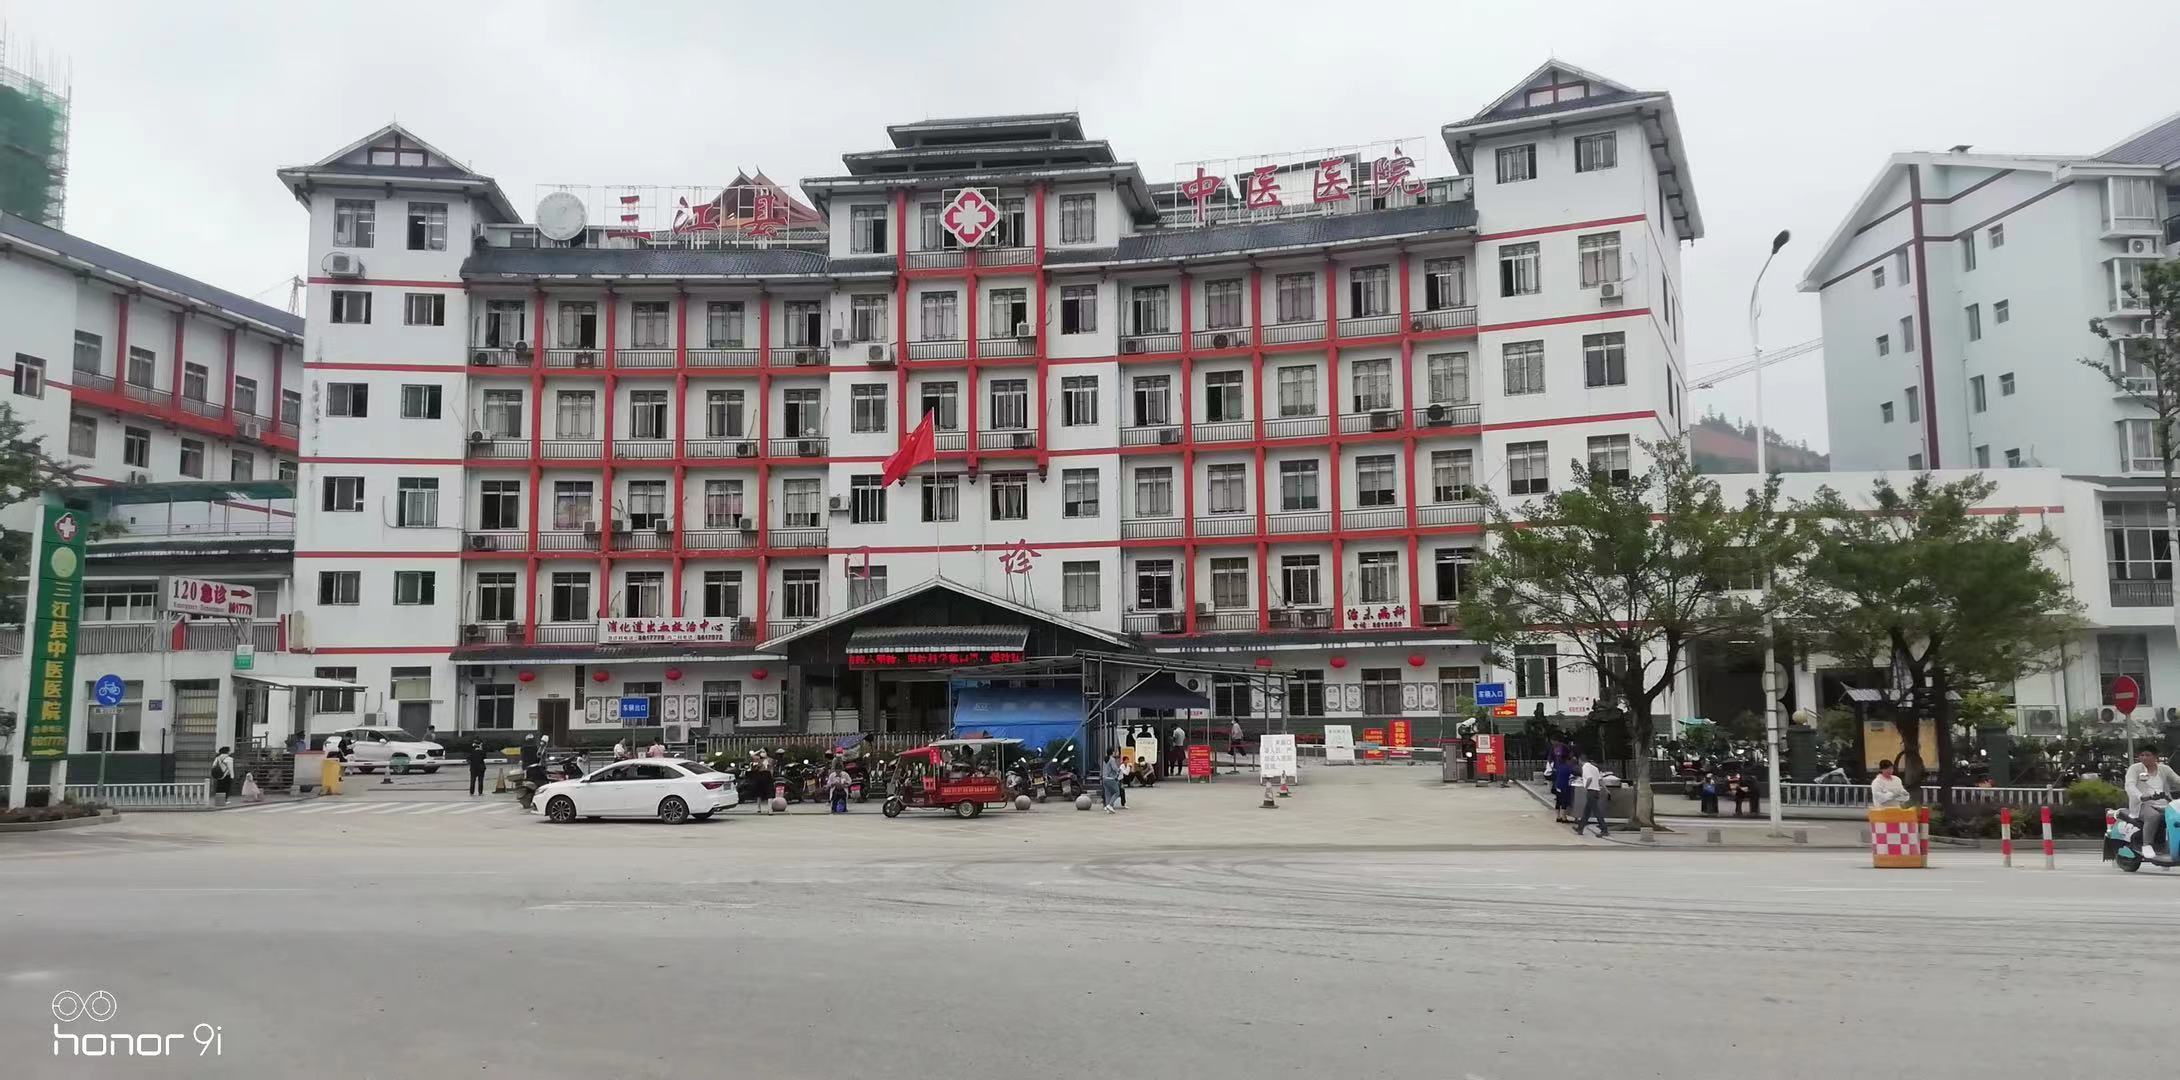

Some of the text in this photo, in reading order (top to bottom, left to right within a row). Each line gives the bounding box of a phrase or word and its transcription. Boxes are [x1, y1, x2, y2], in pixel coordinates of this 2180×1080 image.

[1181, 146, 1426, 223] 中医医院
[606, 195, 789, 238] 三江县
[607, 619, 724, 634] 消化道出血救治中心
[1346, 605, 1406, 621] 治未病科
[43, 581, 73, 721] 三江县中医医院
